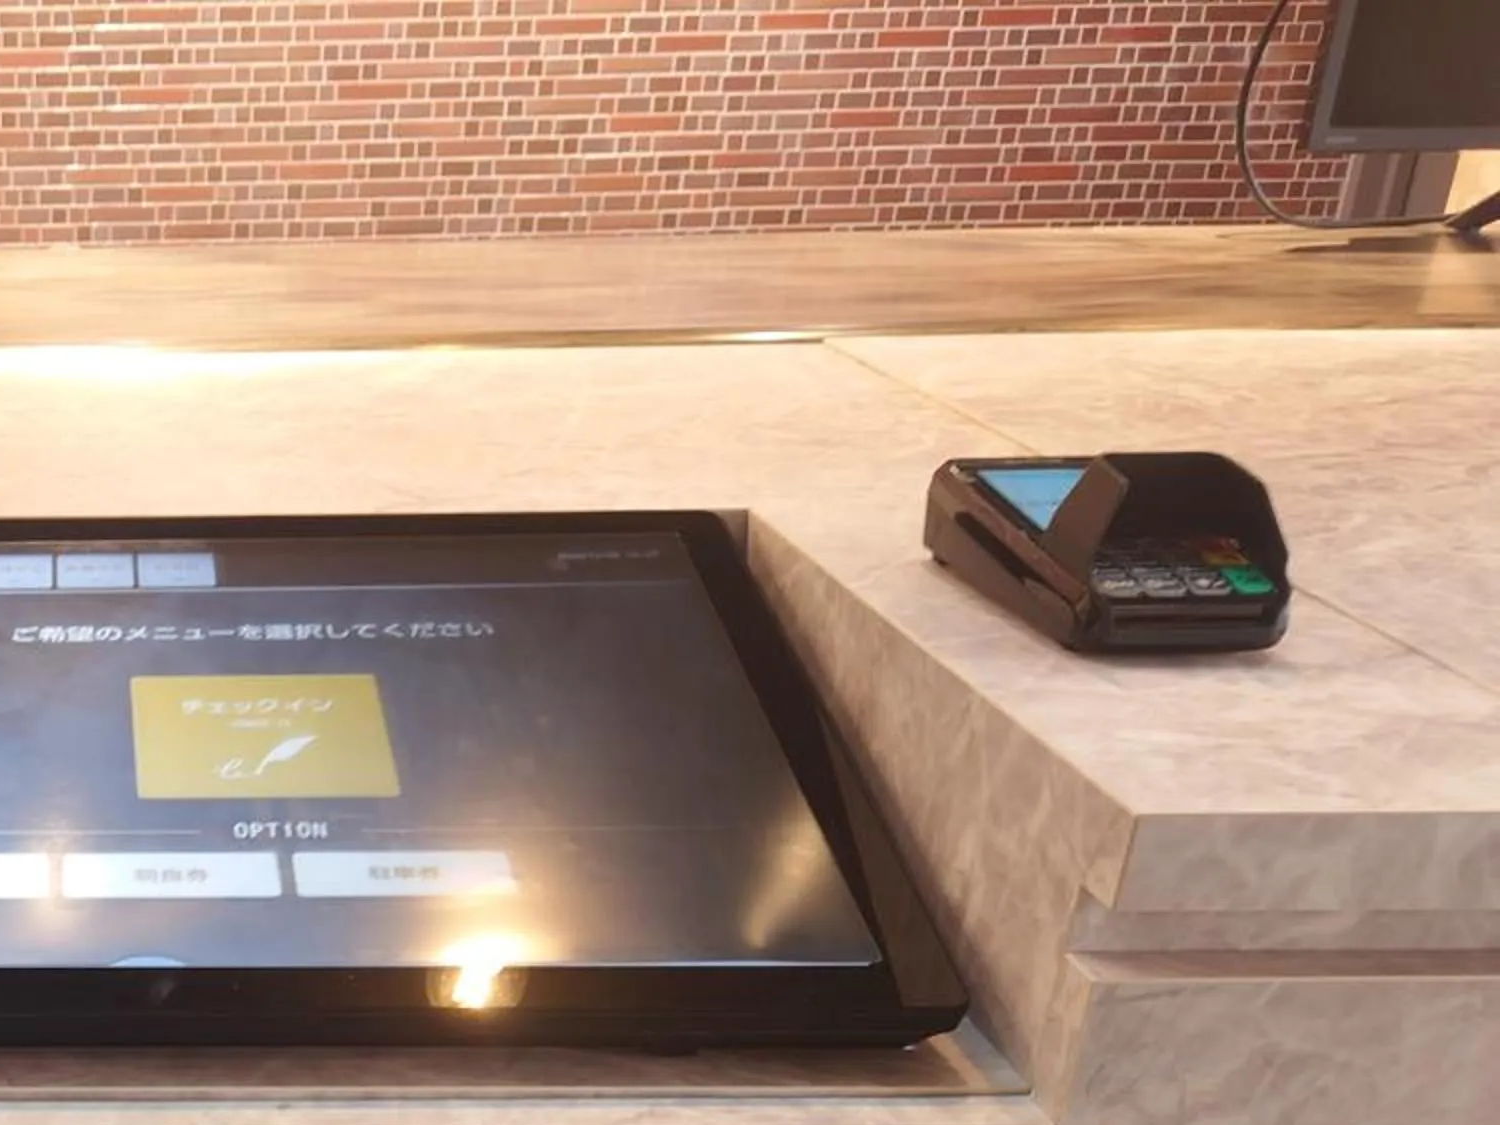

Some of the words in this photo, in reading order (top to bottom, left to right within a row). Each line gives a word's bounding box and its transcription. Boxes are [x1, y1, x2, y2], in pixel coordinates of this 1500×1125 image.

[11, 622, 496, 644] ご希望のメニューを選択してください
[181, 697, 335, 717] チェックイン
[232, 820, 330, 840] OPTION
